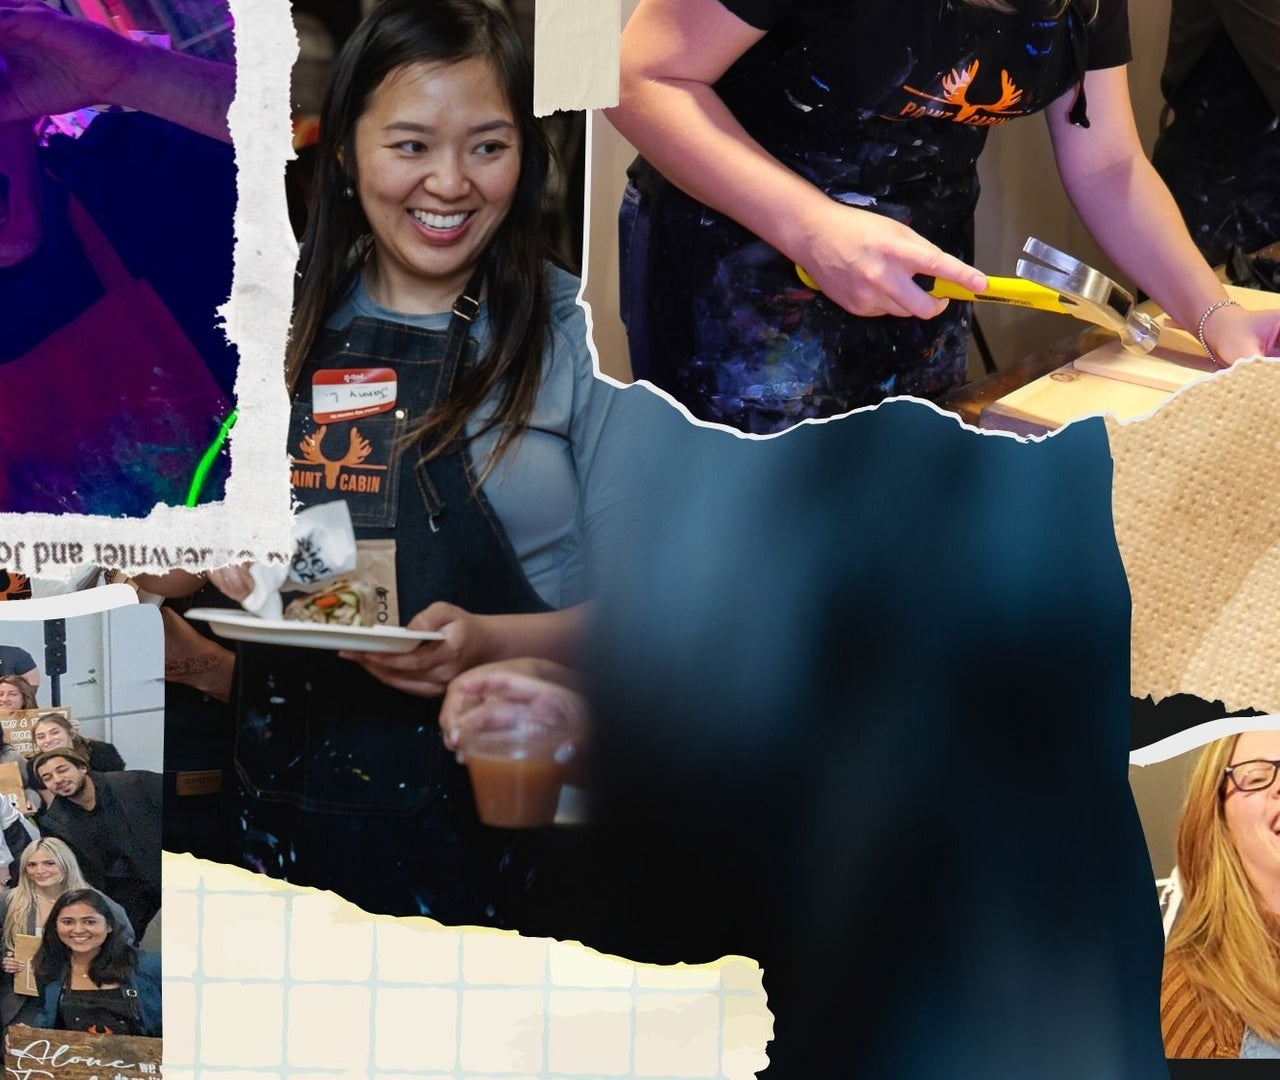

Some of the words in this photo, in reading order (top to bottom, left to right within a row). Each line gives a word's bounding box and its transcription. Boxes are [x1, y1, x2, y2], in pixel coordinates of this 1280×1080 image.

[290, 470, 323, 490] AINT
[339, 474, 382, 494] CABIN
[33, 541, 83, 573] and
[7, 1039, 135, 1070] Alone
